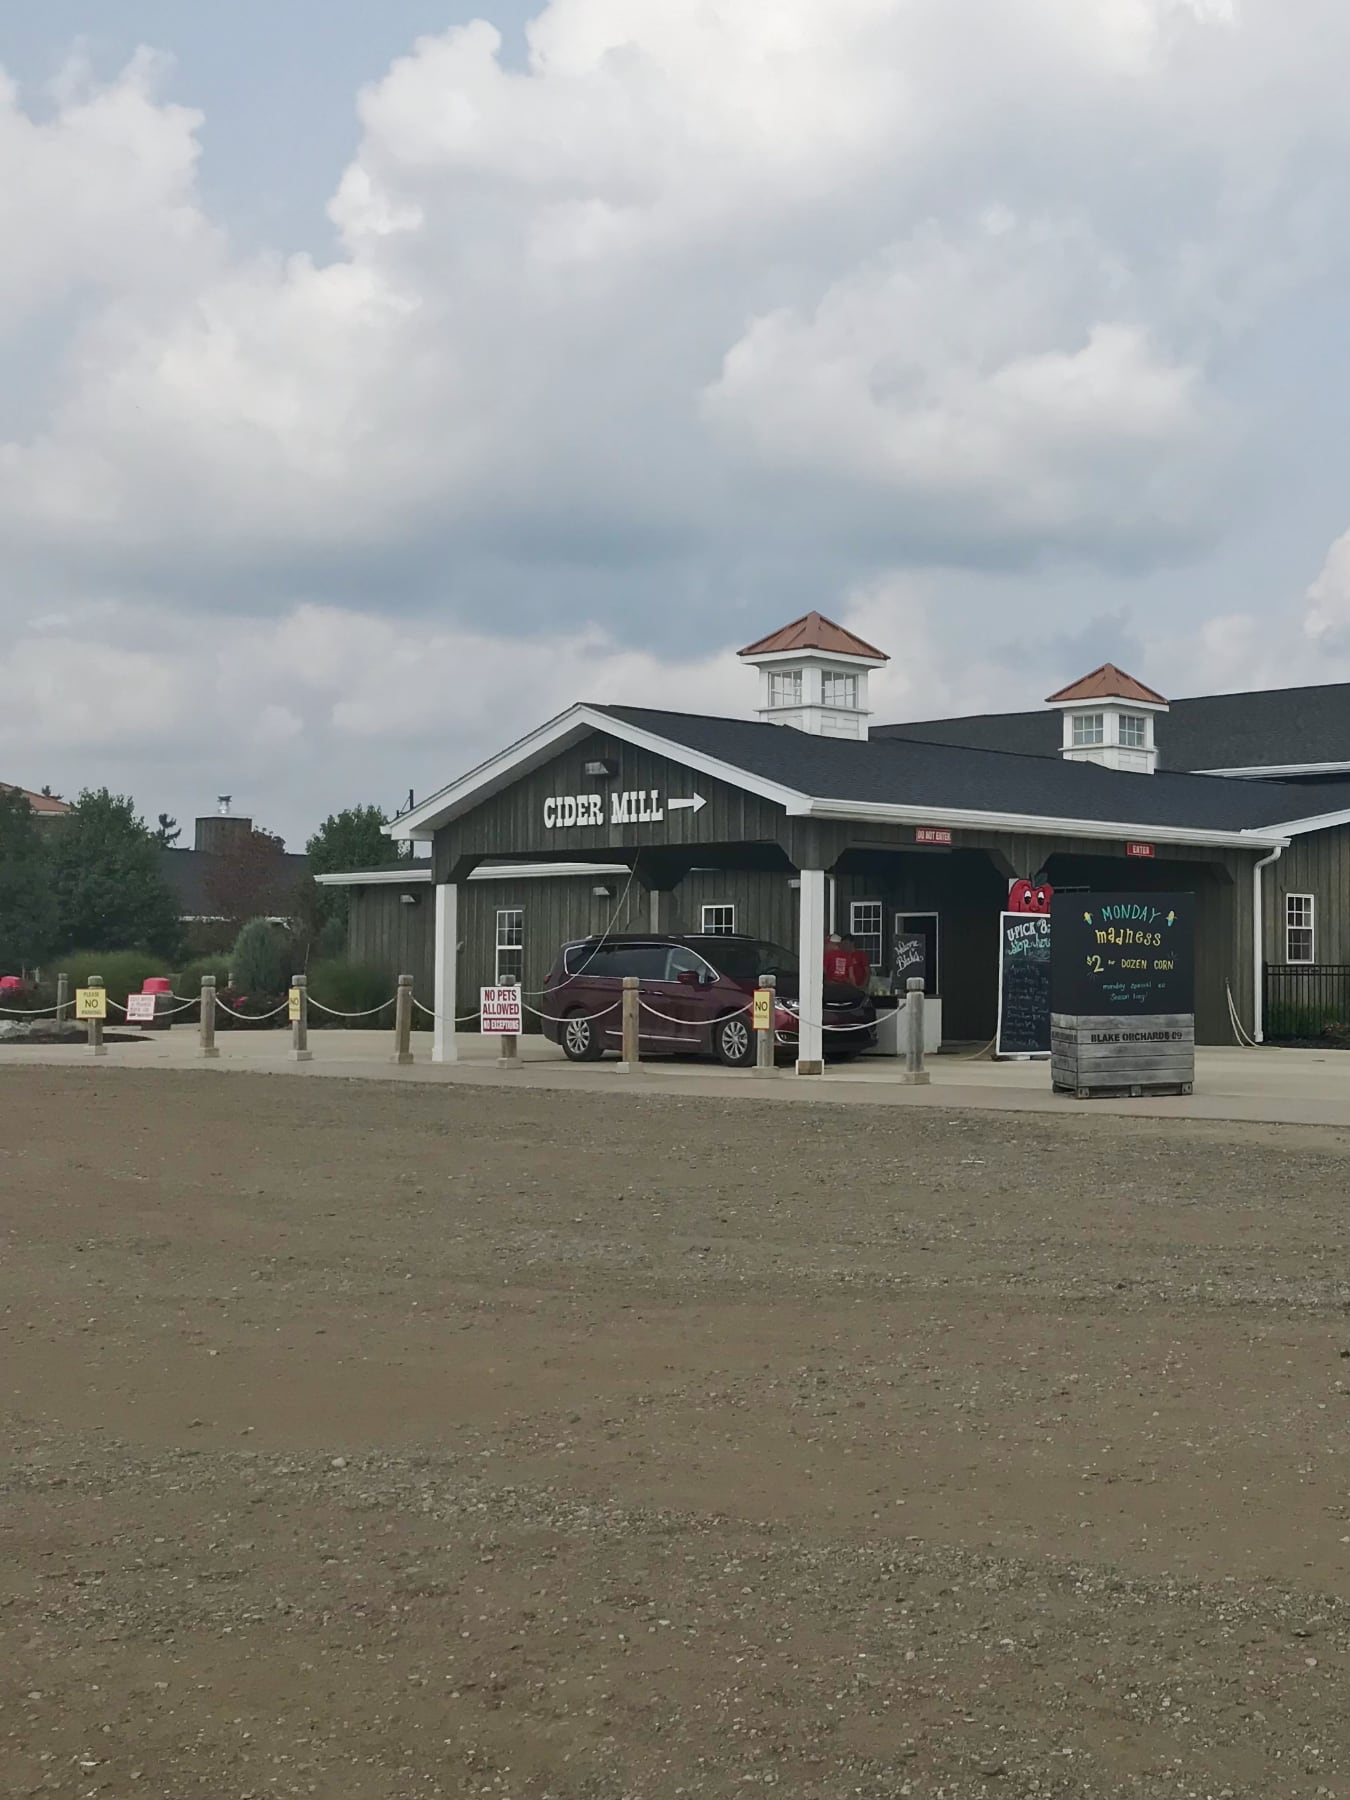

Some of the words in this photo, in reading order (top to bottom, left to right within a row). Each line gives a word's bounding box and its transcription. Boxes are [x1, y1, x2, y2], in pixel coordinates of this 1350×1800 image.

[543, 794, 604, 829] CIDER
[611, 789, 664, 824] MILL
[917, 830, 924, 840] DO
[925, 831, 935, 841] NOT
[936, 831, 952, 841] ENTER
[1132, 845, 1150, 855] ENTER
[1101, 904, 1161, 924] MONDAY
[1095, 927, 1161, 946] madness
[1086, 955, 1104, 973] $2
[1121, 959, 1147, 969] DOZEN
[1154, 960, 1174, 970] CORN
[484, 989, 495, 1002] NO
[498, 989, 517, 1002] PETS
[84, 999, 99, 1009] NO
[483, 1003, 520, 1015] ALLOWED
[755, 1001, 768, 1011] NO
[1091, 1033, 1120, 1043] BLAKE
[1122, 1032, 1170, 1041] ORCHARDS
